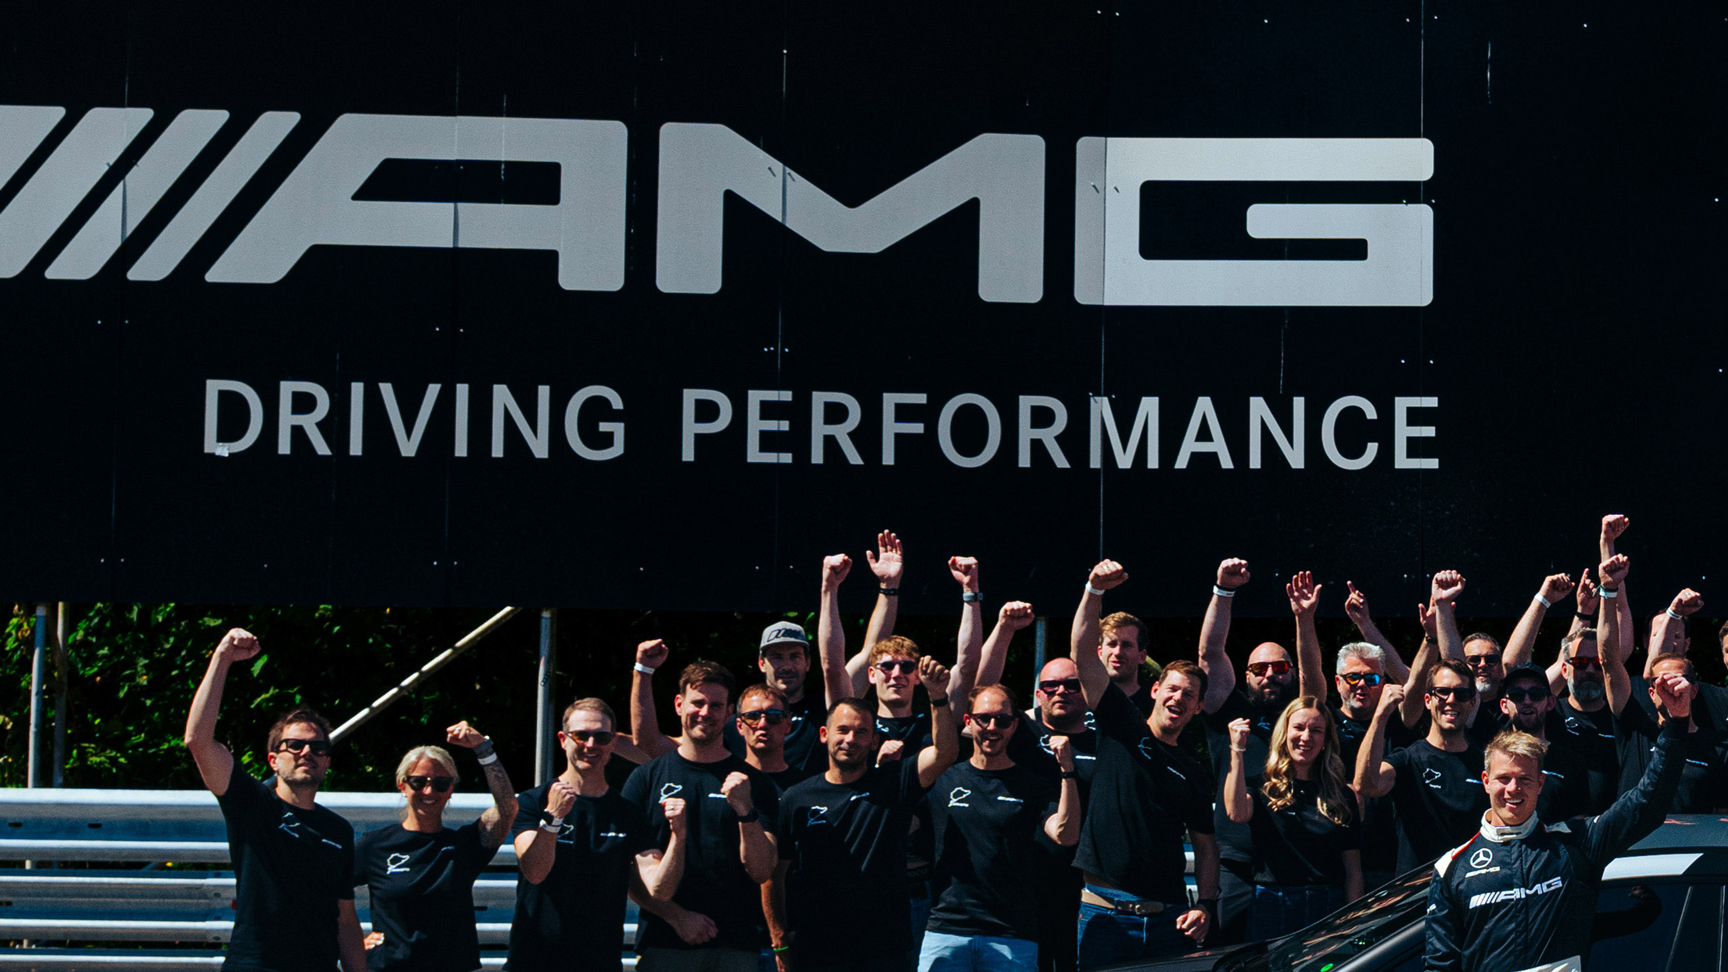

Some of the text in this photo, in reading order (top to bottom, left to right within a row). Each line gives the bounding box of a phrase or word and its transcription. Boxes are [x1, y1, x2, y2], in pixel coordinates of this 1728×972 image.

[205, 112, 1434, 306] AMG
[203, 379, 1440, 470] DRIVING PERFORMANCE
[1490, 876, 1563, 904] AMG
